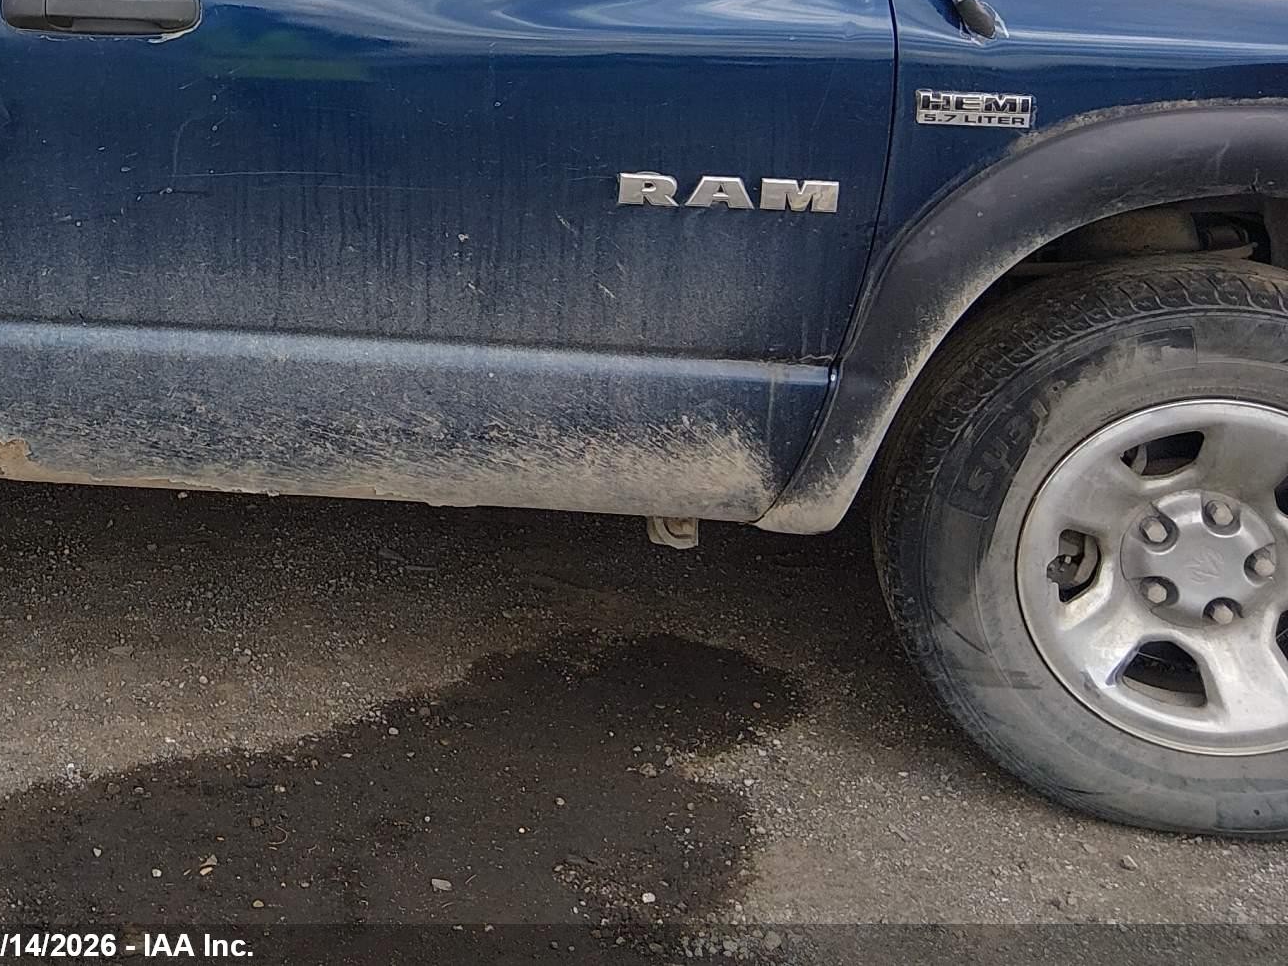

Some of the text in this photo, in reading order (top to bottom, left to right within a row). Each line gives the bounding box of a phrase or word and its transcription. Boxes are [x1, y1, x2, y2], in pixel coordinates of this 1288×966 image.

[918, 91, 1032, 113] HEMI
[924, 114, 1025, 126] 5.7 LITER
[618, 172, 840, 213] RAM
